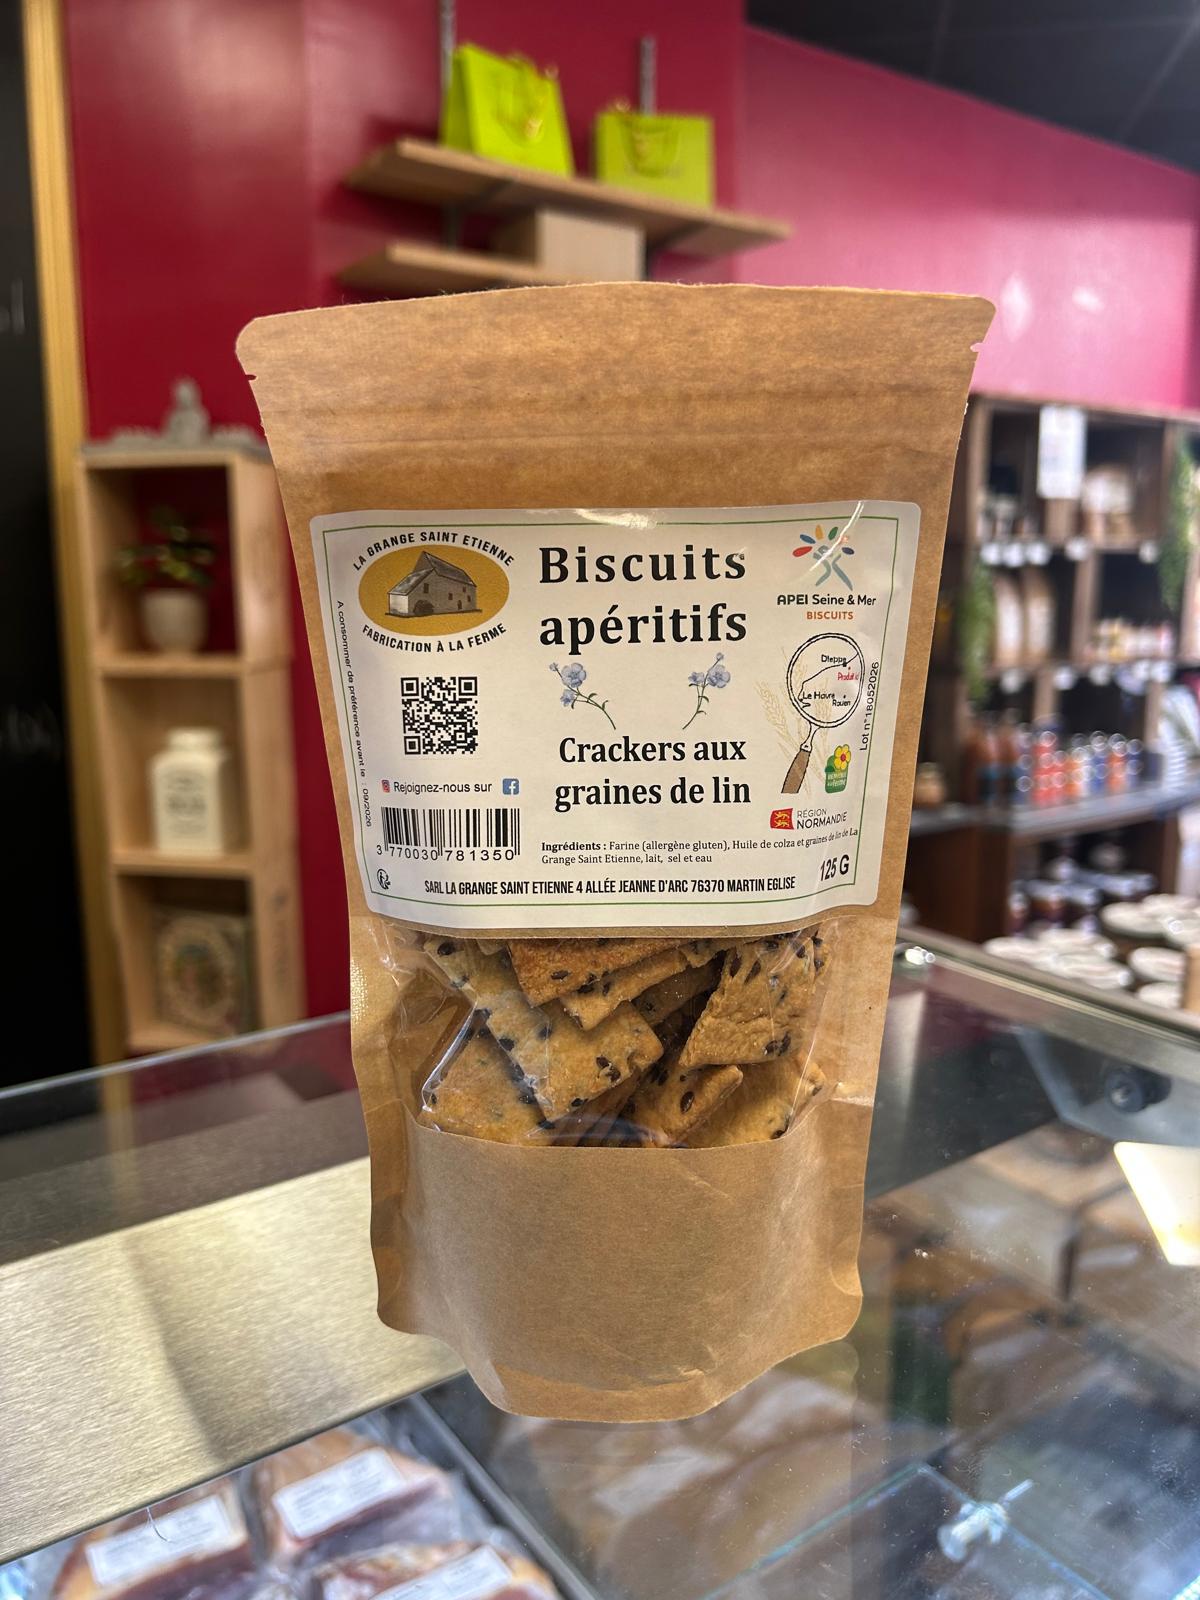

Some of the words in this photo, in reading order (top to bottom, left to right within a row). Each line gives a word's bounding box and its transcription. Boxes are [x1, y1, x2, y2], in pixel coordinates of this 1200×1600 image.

[353, 555, 367, 571] LA
[367, 532, 415, 557] GRANGE
[420, 531, 458, 543] SAINT
[462, 534, 514, 566] ETIENNE
[539, 544, 746, 583] Biscuits
[777, 594, 808, 606] APEI
[812, 594, 845, 606] Seine
[847, 595, 855, 606] &
[857, 595, 876, 606] Mer
[539, 602, 747, 656] apéritifs
[806, 611, 854, 621] BISCUITS
[339, 611, 352, 669] consommer
[362, 624, 432, 653] FABRICATION
[436, 640, 445, 653] À
[449, 641, 464, 652] LA
[468, 622, 506, 648] FERME
[347, 670, 354, 684] de
[802, 691, 812, 700] Le
[348, 685, 361, 737] préférence
[356, 740, 366, 766] avant
[559, 735, 686, 763] Crackers
[693, 740, 747, 761] aux
[859, 734, 869, 751] Lot
[393, 781, 471, 795] Rejoignez-nous
[474, 783, 493, 793] sur
[554, 778, 662, 813] graines
[670, 777, 705, 804] de
[712, 776, 751, 804] lin
[362, 788, 372, 828] 09/2026
[796, 808, 827, 819] RÉGION
[796, 811, 848, 830] NORMANDIE
[376, 844, 383, 855] 3
[389, 846, 439, 861] 770030
[444, 849, 515, 862] 781350
[541, 841, 601, 853] Ingrédients
[609, 841, 640, 851] Farine
[642, 841, 691, 853] (allergène
[693, 840, 730, 852] gluten),
[732, 839, 757, 850] Huile
[760, 839, 771, 849] de
[773, 838, 795, 848] colza
[796, 838, 804, 847] et
[805, 835, 828, 848] graines
[849, 827, 858, 836] La
[541, 854, 576, 866] Grange
[578, 854, 602, 864] Saint
[605, 854, 643, 865] Etienne,
[645, 853, 664, 865] lait,
[667, 853, 681, 863] sel
[684, 854, 693, 863] et
[695, 855, 712, 863] eau
[820, 857, 838, 882] 125
[839, 854, 850, 875] G
[424, 880, 445, 893] SARL
[445, 881, 457, 895] LA
[458, 881, 498, 895] GRANGE
[500, 881, 530, 894] SAINT
[532, 880, 574, 894] ETIENNE
[576, 881, 583, 893] 4
[585, 878, 616, 893] ALLÉE
[618, 879, 656, 893] JEANNE
[658, 880, 689, 892] D'ARC
[691, 879, 724, 892] 76370
[727, 878, 765, 892] MARTIN
[767, 876, 796, 890] EGLISE
